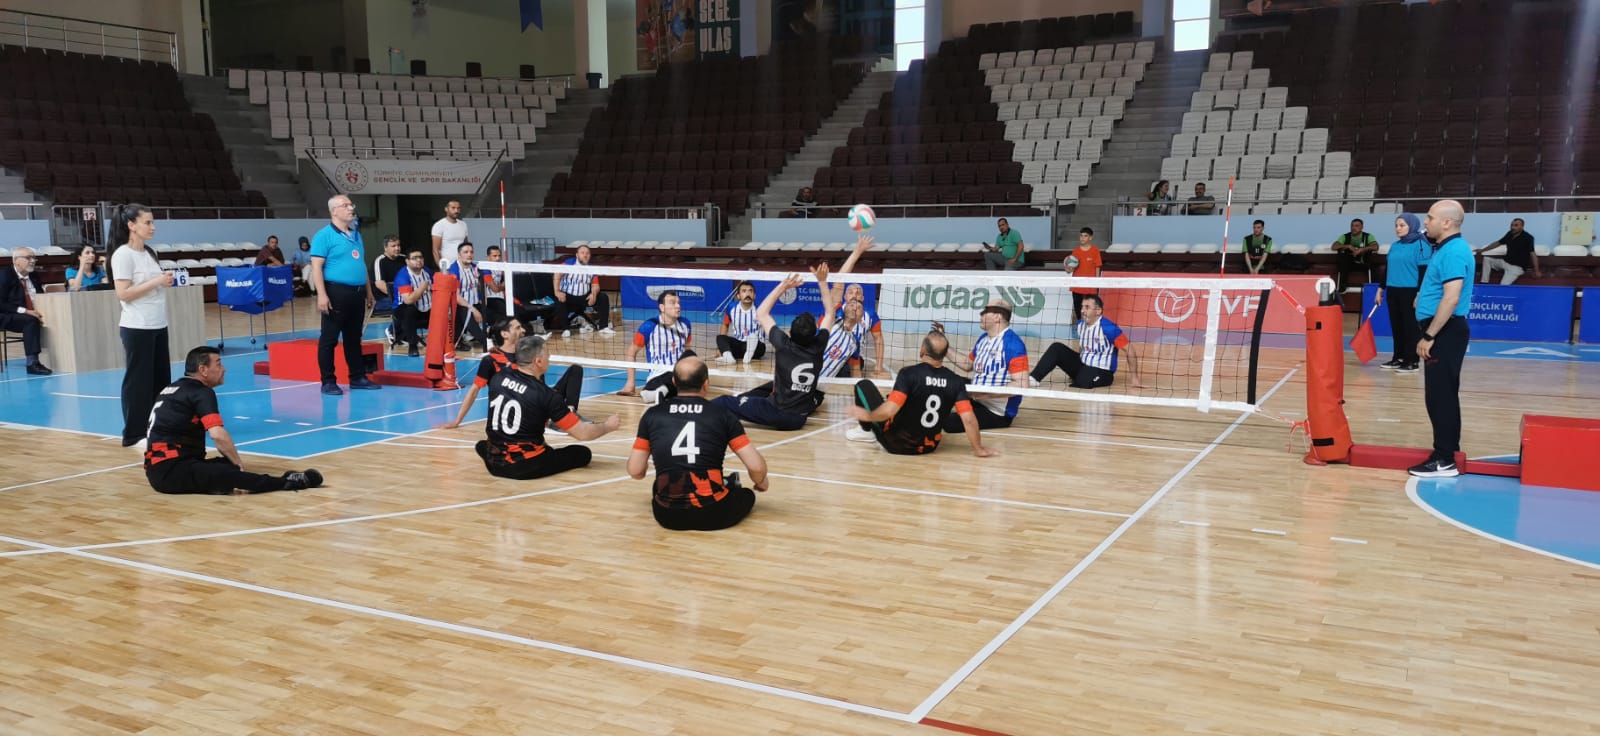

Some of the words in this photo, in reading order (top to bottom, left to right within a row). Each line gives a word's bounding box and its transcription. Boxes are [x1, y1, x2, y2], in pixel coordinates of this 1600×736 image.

[700, 26, 731, 54] ULAŞ
[373, 175, 406, 184] GENÇLİK
[442, 175, 481, 183] BAKANLIĞI
[179, 275, 186, 285] 6
[1469, 302, 1501, 311] ENÇLİK
[1502, 303, 1514, 311] VE
[1469, 312, 1519, 322] BAKANLIĞI
[790, 362, 815, 386] 6
[501, 377, 528, 394] BOLU
[925, 376, 948, 388] BOLU
[489, 394, 522, 435] 10
[669, 404, 703, 414] BOLU
[920, 394, 942, 428] 8
[671, 421, 700, 464] 4
